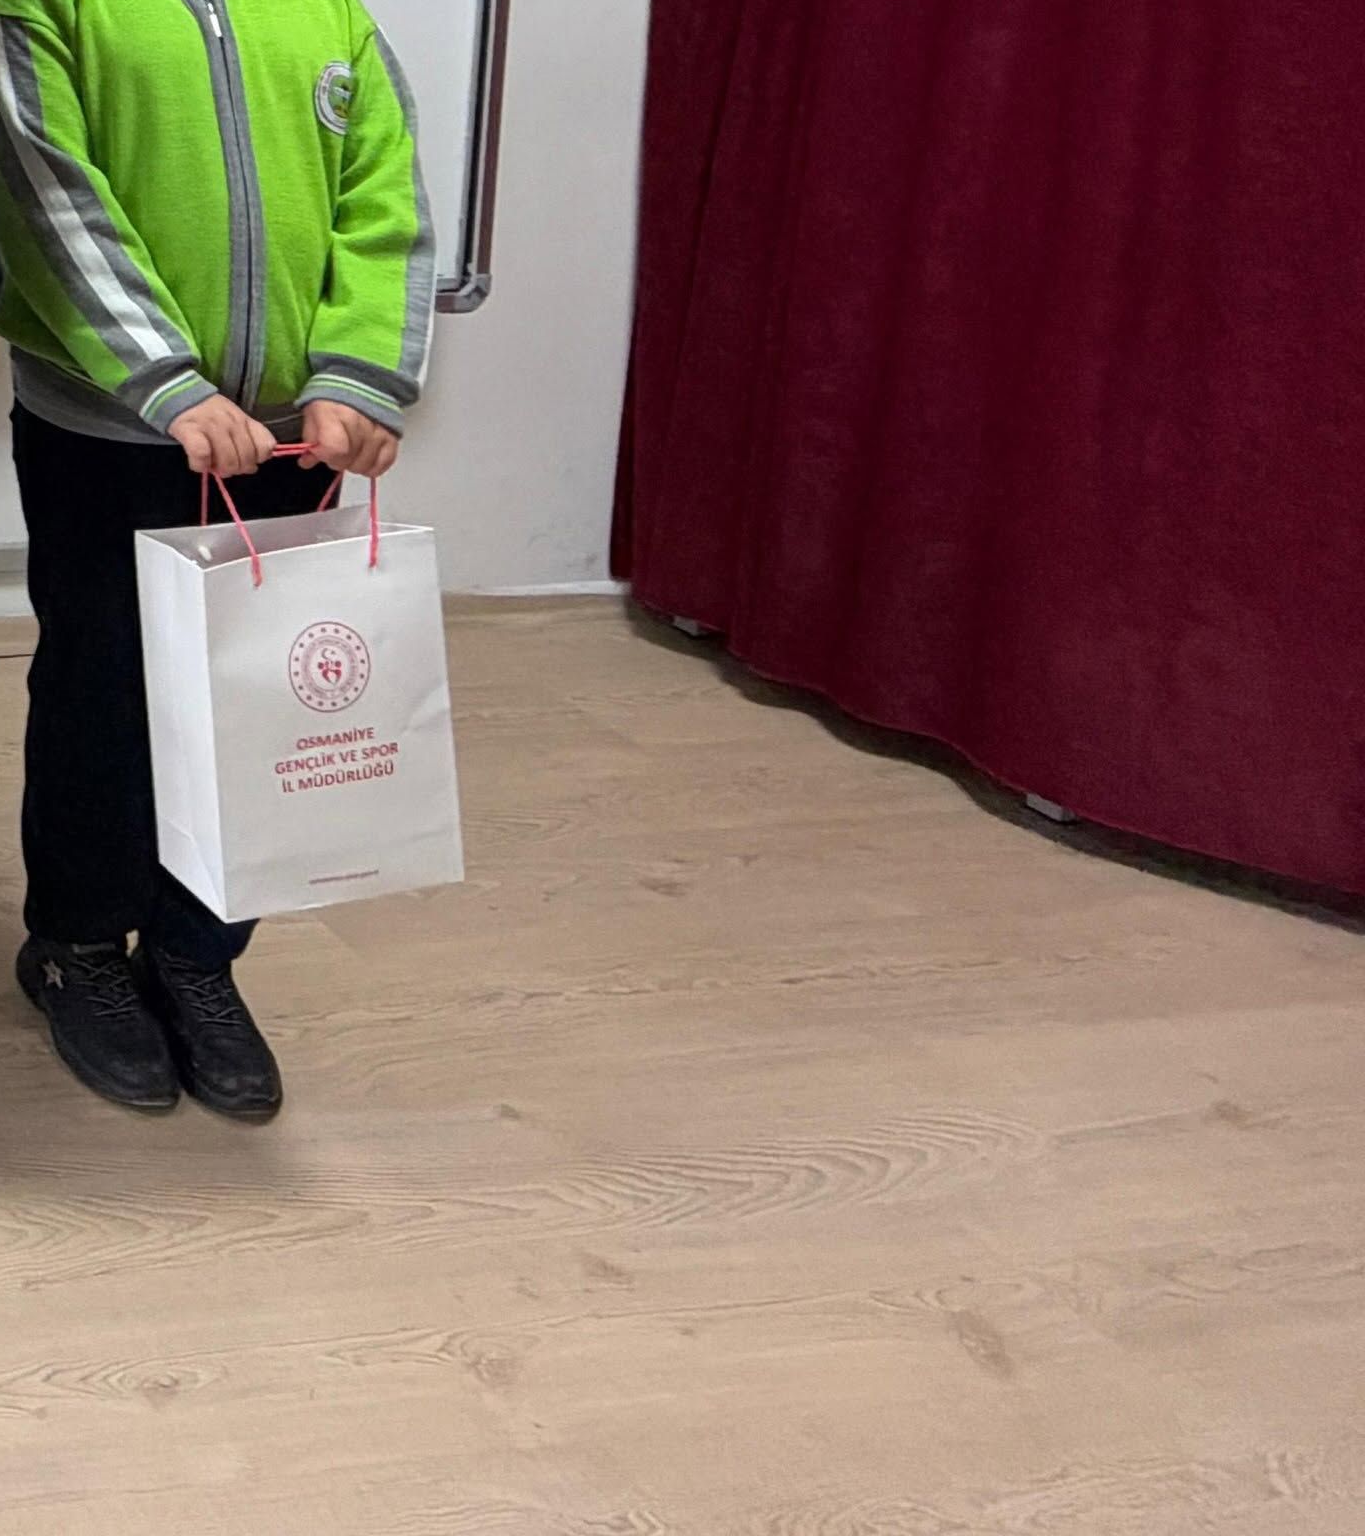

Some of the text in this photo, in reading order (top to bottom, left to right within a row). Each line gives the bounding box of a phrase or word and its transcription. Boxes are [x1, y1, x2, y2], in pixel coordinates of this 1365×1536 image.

[296, 727, 374, 750] OSMANİYE
[275, 742, 399, 775] GENÇLİK VE SPOR
[282, 760, 394, 793] İL MÜDÜRLÜĞÜ
